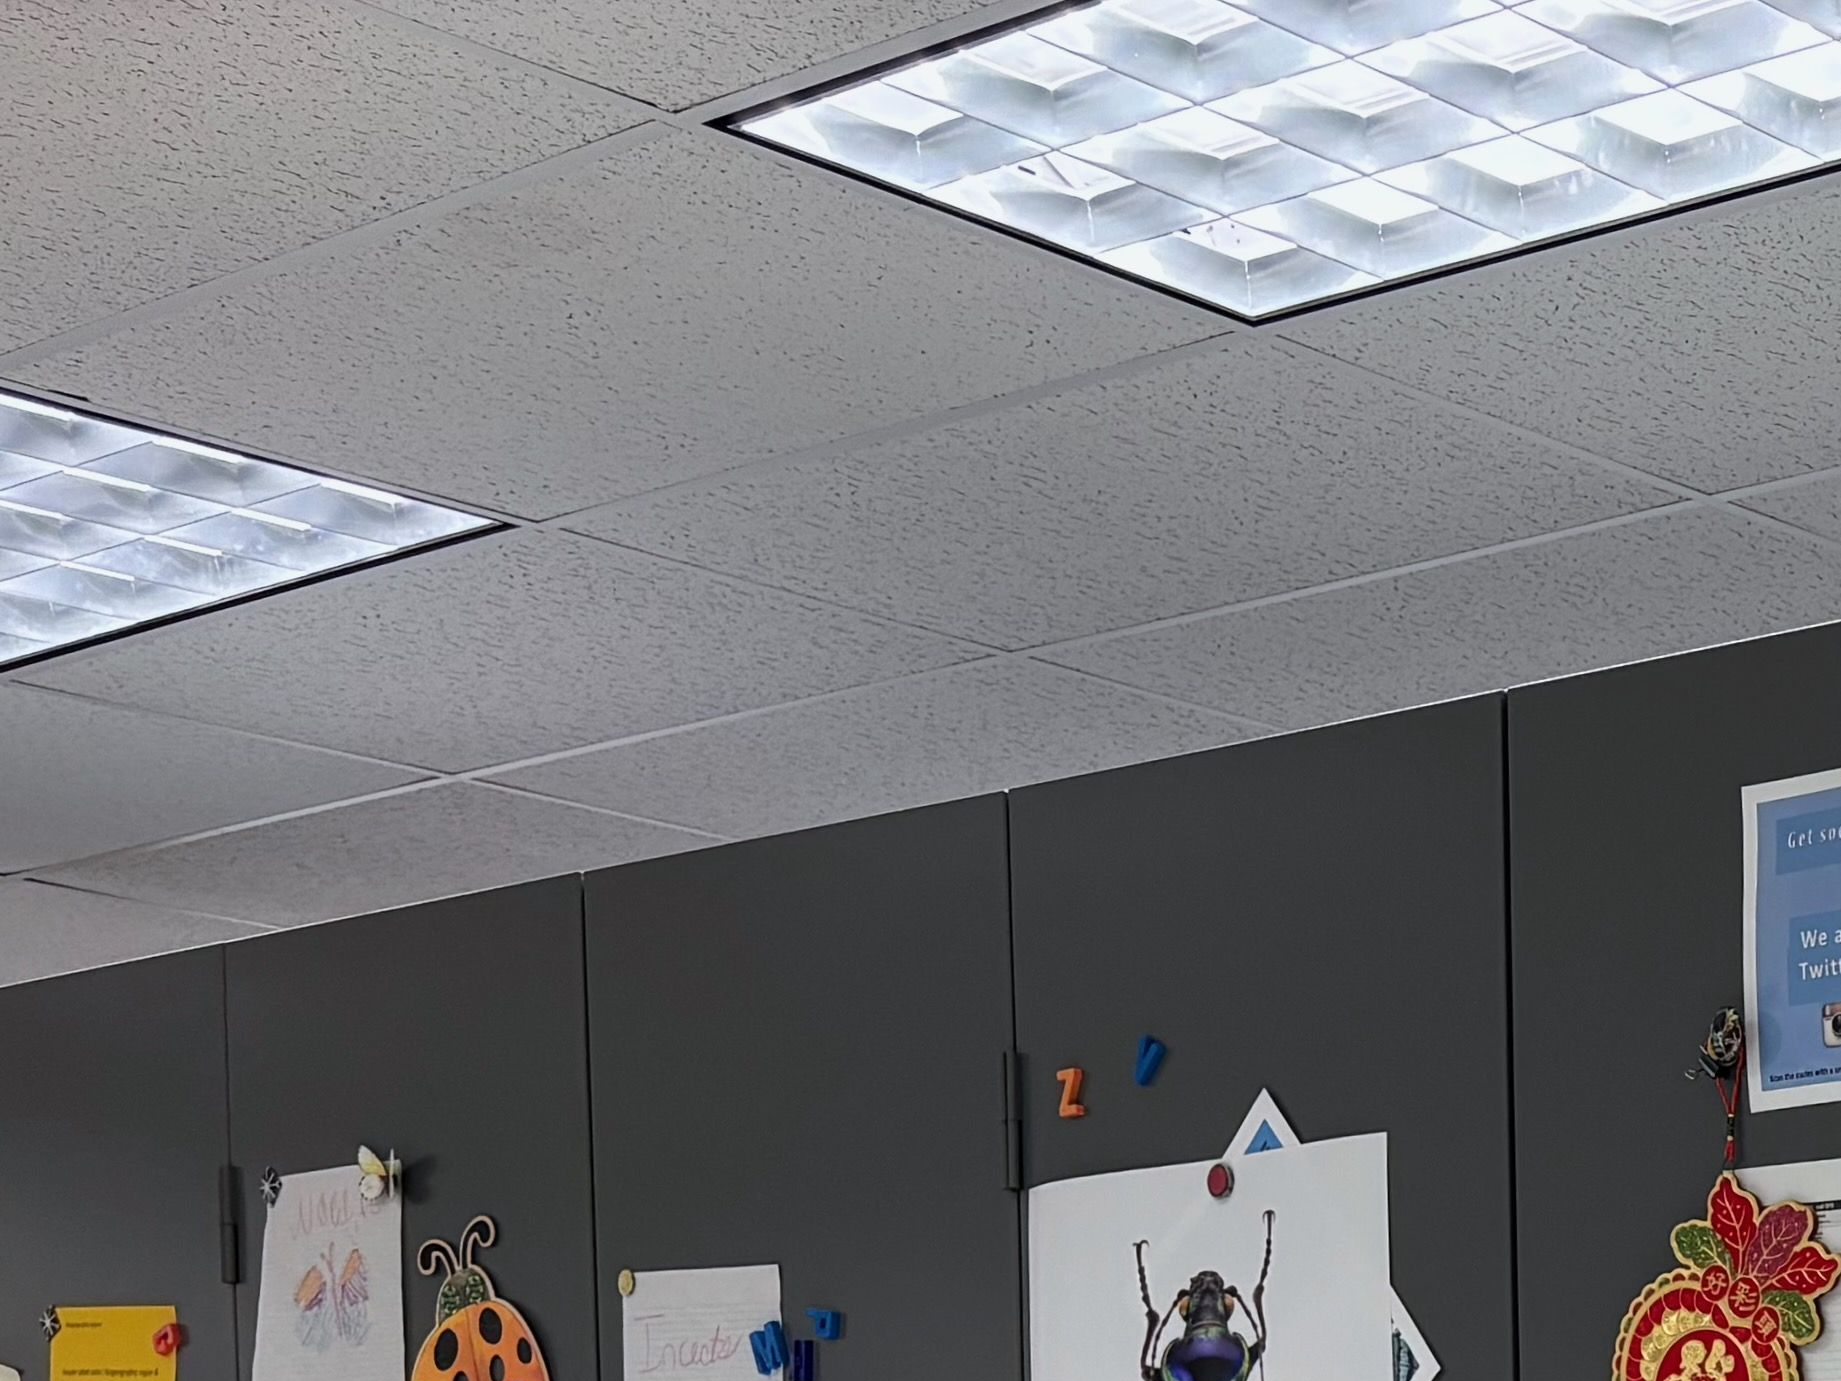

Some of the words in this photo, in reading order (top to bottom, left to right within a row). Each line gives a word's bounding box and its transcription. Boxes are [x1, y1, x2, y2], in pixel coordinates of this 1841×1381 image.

[1788, 828, 1813, 849] Get
[1800, 928, 1828, 949] We
[749, 1320, 789, 1376] M
